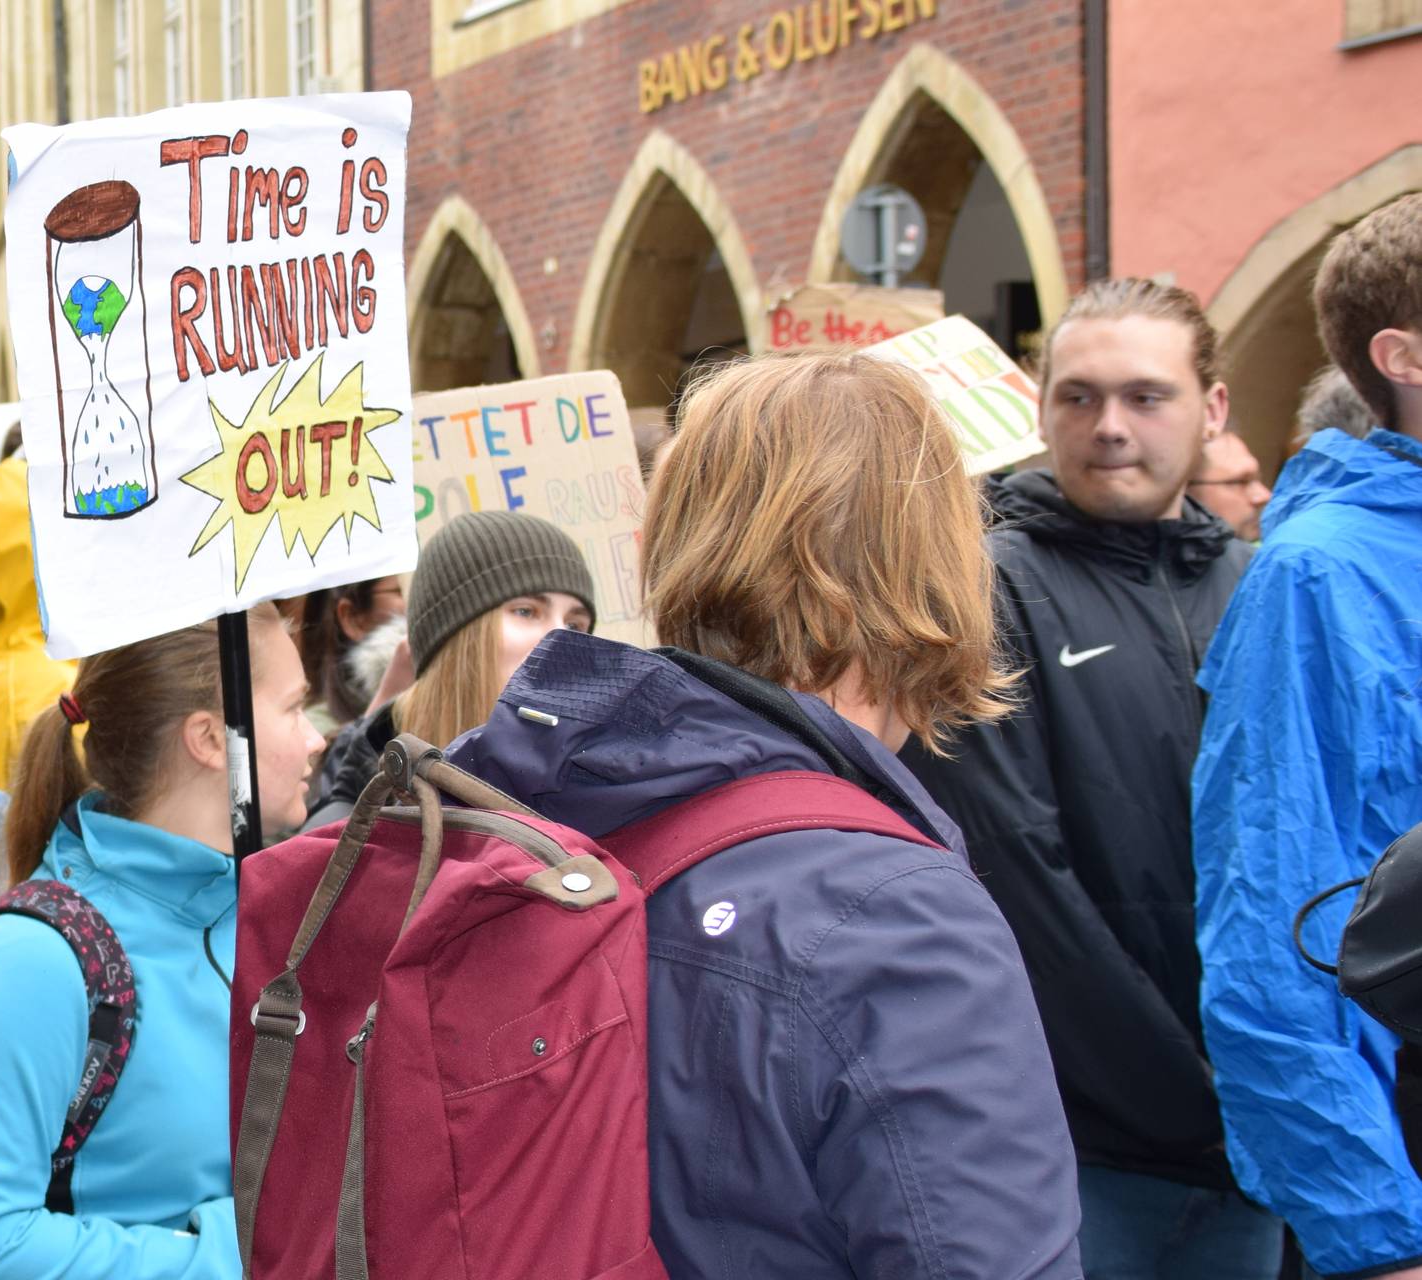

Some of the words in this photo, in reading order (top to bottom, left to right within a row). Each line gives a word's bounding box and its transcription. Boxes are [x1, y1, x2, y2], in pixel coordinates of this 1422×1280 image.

[638, 34, 727, 114] BANG
[734, 23, 762, 81] &
[160, 129, 309, 244] Time
[336, 127, 389, 235] is
[170, 248, 376, 382] RUNNING
[235, 416, 363, 515] OUT!
[555, 394, 614, 444] DIE
[545, 465, 644, 525] RAUS
